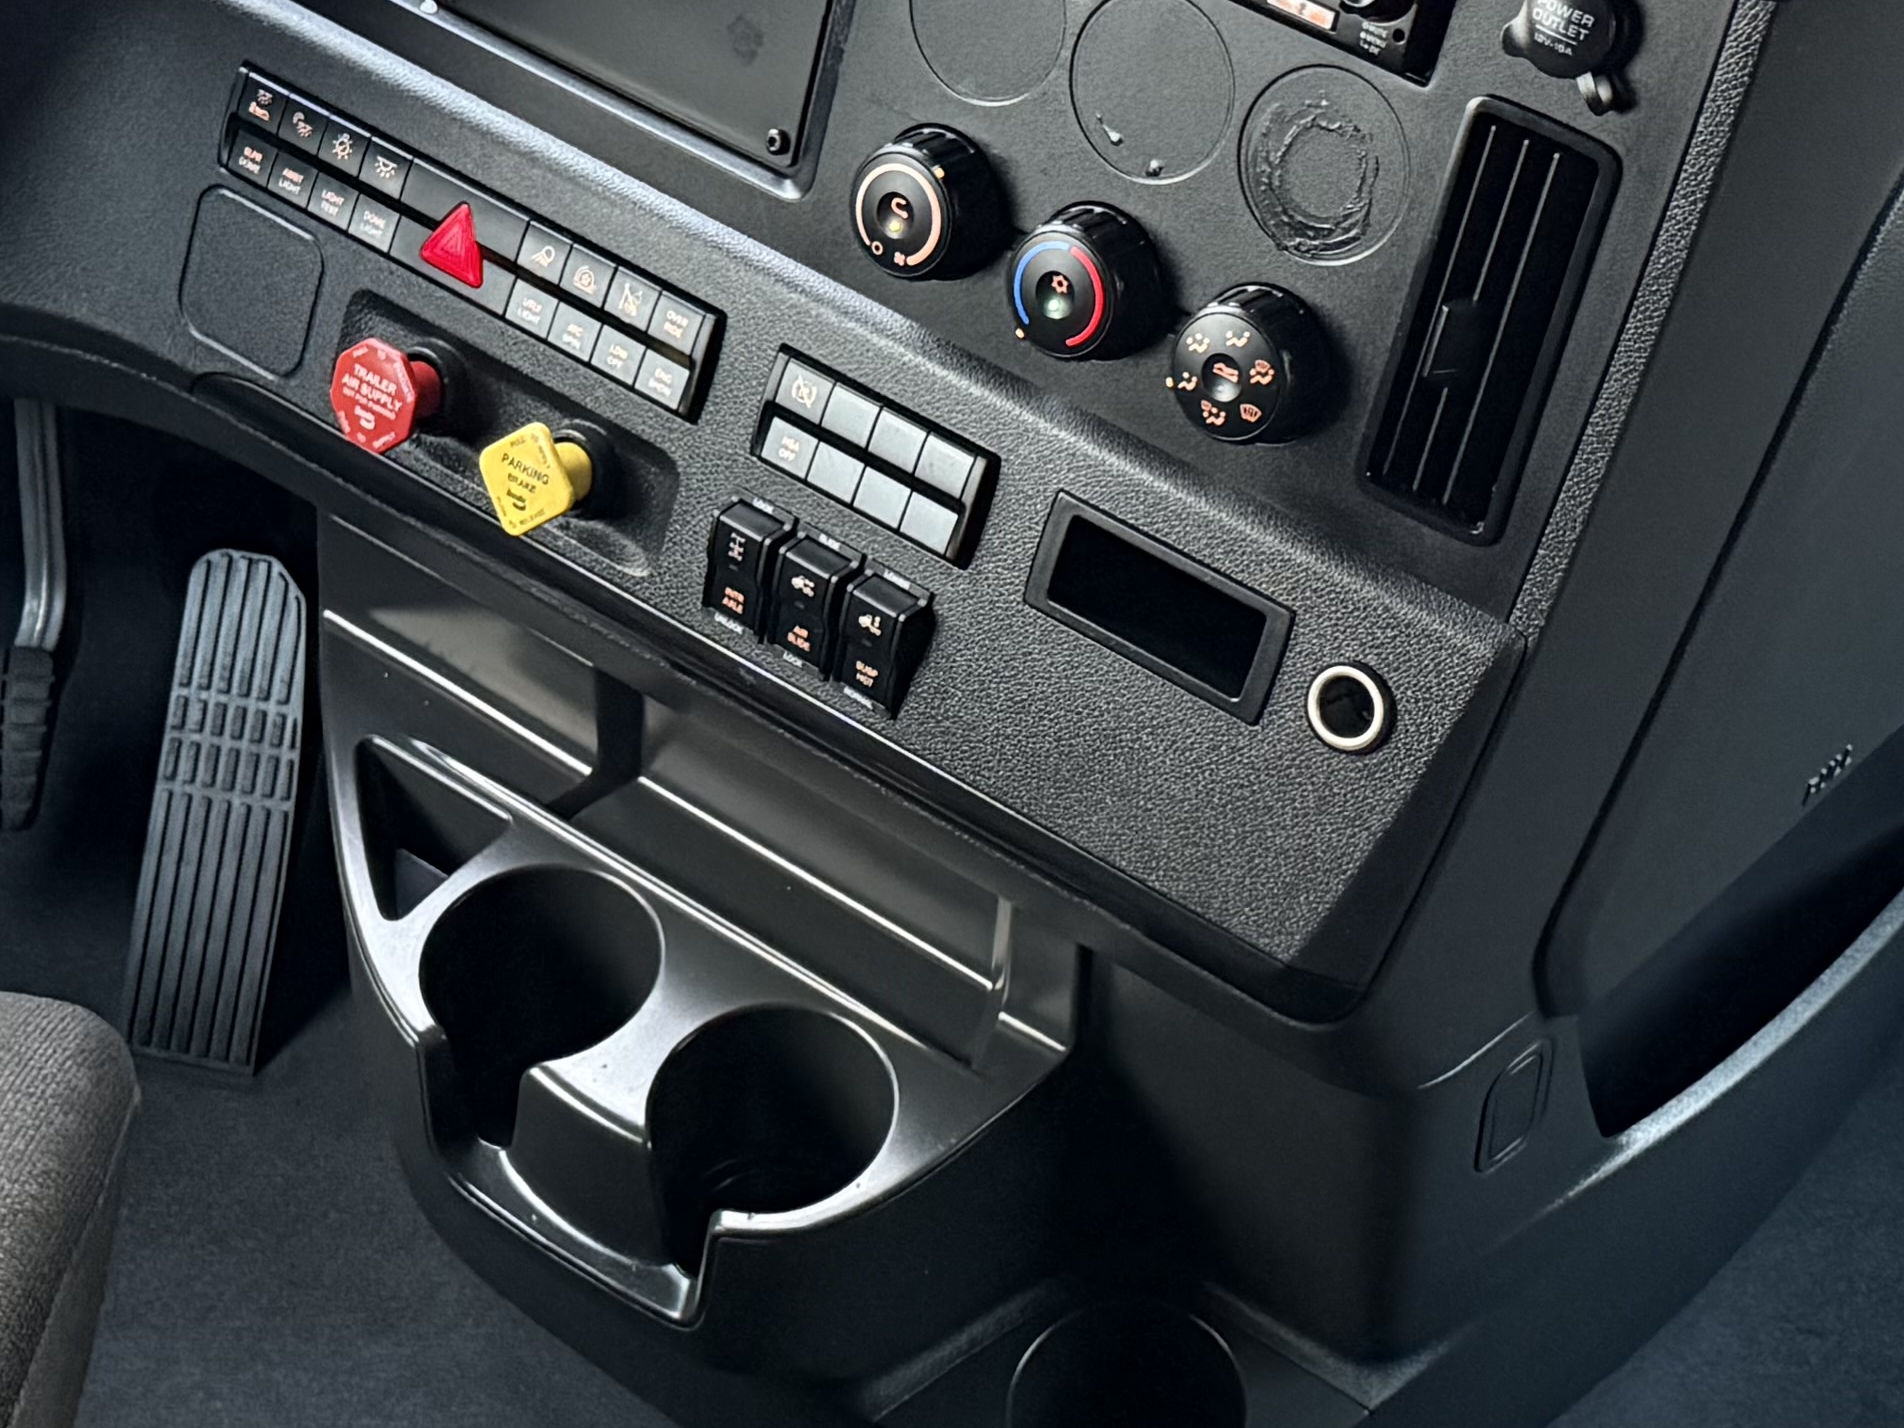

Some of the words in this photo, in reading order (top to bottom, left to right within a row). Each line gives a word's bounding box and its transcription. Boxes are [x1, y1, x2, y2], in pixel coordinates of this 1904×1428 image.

[1532, 7, 1590, 41] OUTLET
[666, 309, 689, 327] OVER
[342, 372, 361, 391] AIR
[354, 363, 397, 397] TRAILER
[360, 382, 403, 413] SUPPLY
[501, 452, 550, 486] PARKING
